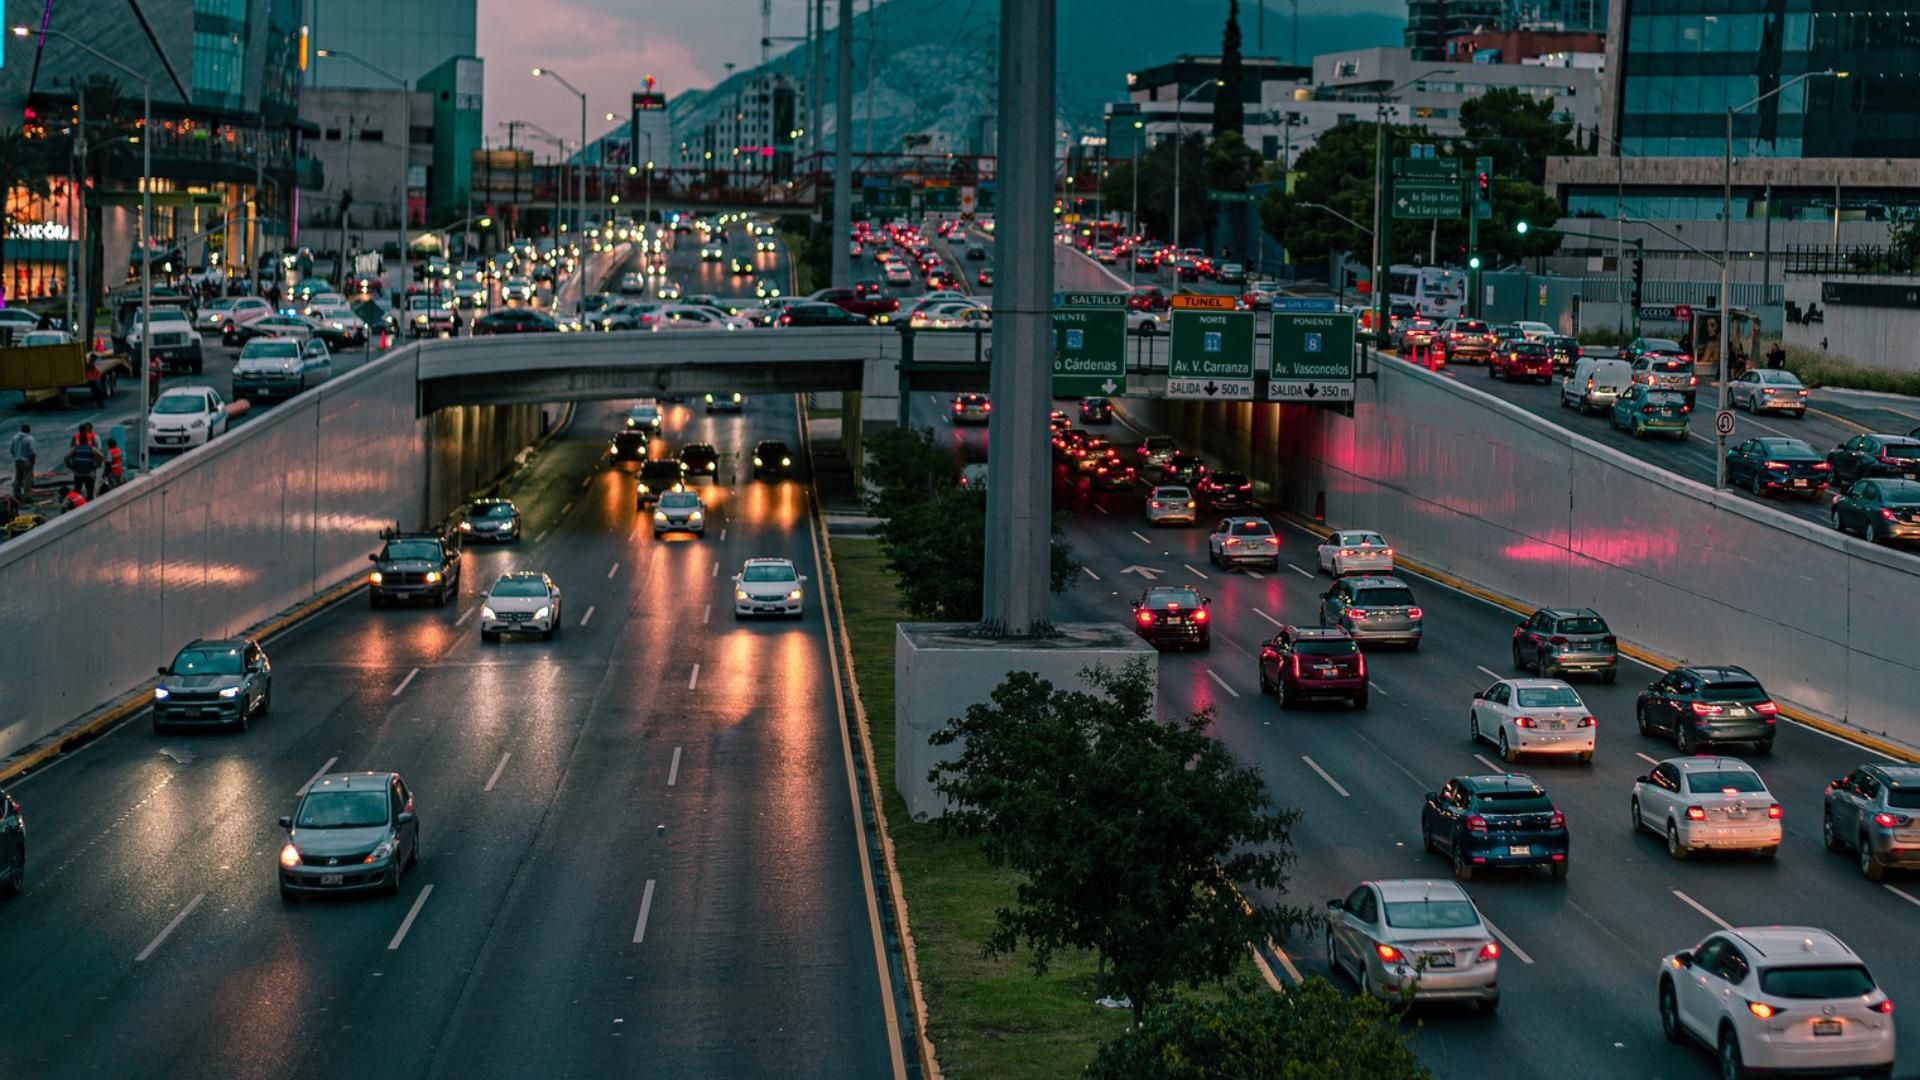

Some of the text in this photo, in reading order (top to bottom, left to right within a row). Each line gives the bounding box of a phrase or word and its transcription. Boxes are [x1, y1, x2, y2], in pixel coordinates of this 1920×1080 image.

[1071, 295, 1121, 305] SALTILLO
[1184, 297, 1223, 306] TUNEL
[1641, 308, 1671, 316] CCESO
[1052, 313, 1088, 322] NIENTE
[1200, 316, 1227, 324] NORTE
[1293, 317, 1335, 326] PONIENTE
[1308, 338, 1318, 351] 8
[1064, 358, 1118, 371] Cárdenas
[1175, 360, 1249, 374] Av. V. Carranza
[1275, 361, 1350, 375] Av. Vasconcelos
[1170, 382, 1201, 394] SALIDA
[1221, 384, 1239, 395] 500
[1271, 385, 1303, 396] SALIDA
[1321, 386, 1339, 396] 350
